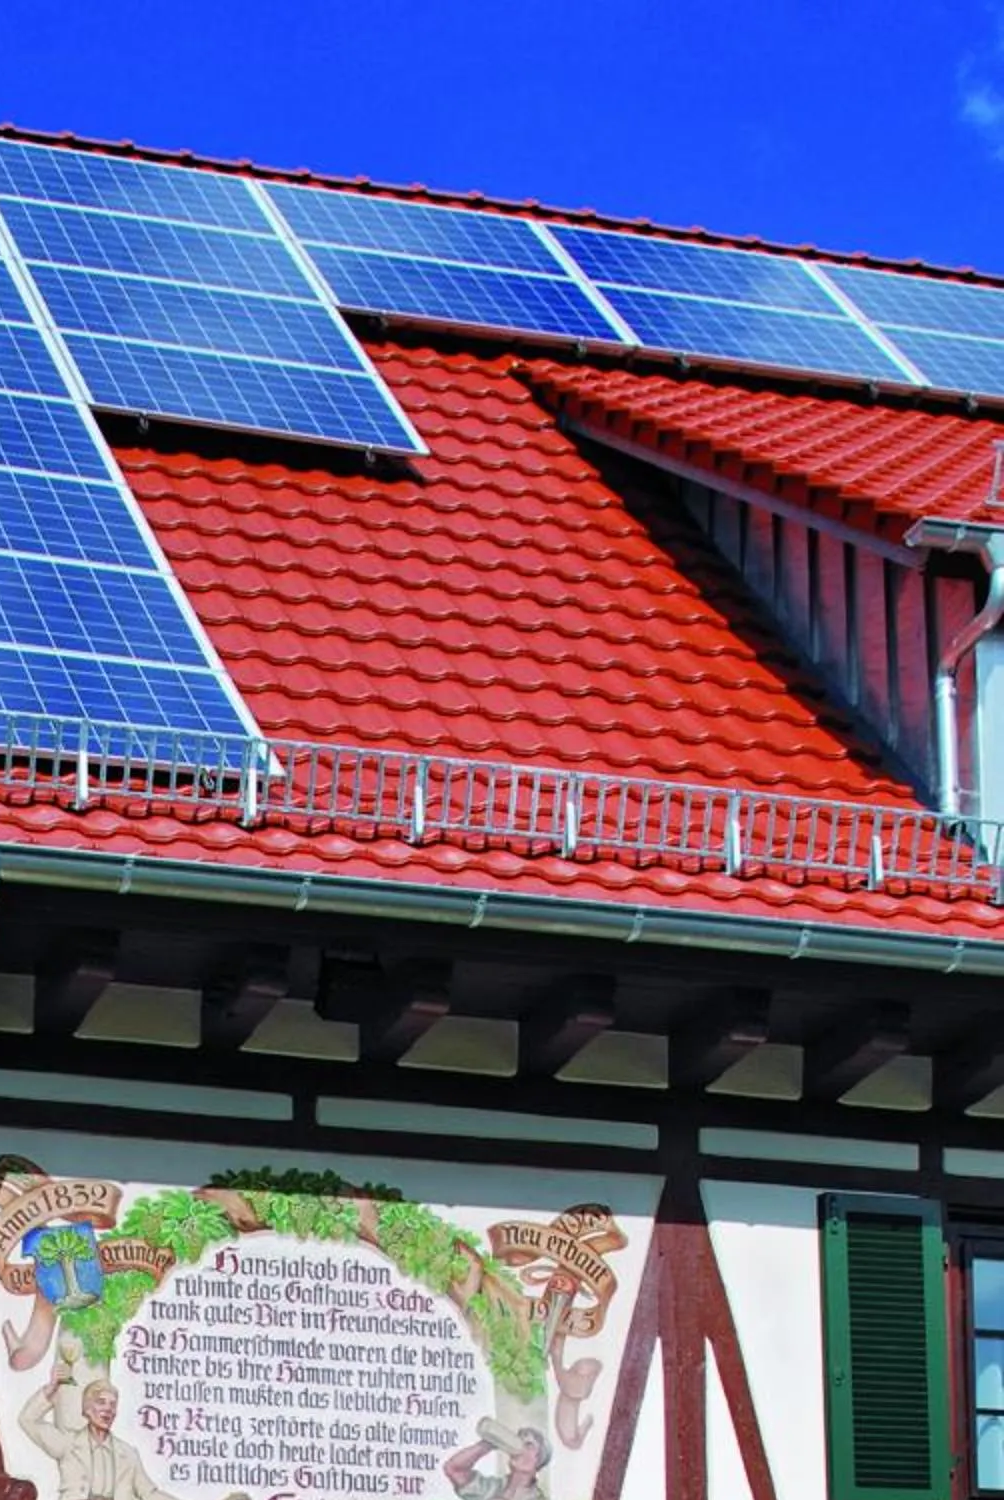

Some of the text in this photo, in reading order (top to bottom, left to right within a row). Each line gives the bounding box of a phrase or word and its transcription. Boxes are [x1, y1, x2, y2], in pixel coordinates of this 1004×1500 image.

[501, 1224, 541, 1246] Neu
[546, 1235, 608, 1283] erbaut
[246, 1278, 281, 1301] das
[150, 1299, 201, 1322] trank
[203, 1304, 253, 1328] gutes
[254, 1303, 297, 1328] Bier
[299, 1308, 326, 1329] im
[126, 1325, 166, 1349] Die
[327, 1342, 387, 1365] waren
[391, 1344, 418, 1366] die
[123, 1350, 201, 1377] Trinker
[205, 1357, 233, 1379] bis
[236, 1358, 273, 1383] ihre
[357, 1366, 416, 1390] ruhten
[420, 1370, 455, 1393] und
[297, 1386, 330, 1409] das
[332, 1389, 403, 1416] liebliche
[137, 1404, 181, 1429] Der
[184, 1408, 243, 1437] Krieg
[328, 1418, 362, 1442] das
[364, 1419, 396, 1443] alte
[234, 1437, 274, 1461] doch
[278, 1440, 326, 1464] heute
[329, 1442, 374, 1467] ladet
[376, 1446, 402, 1468] ein
[168, 1461, 191, 1482] es
[391, 1474, 426, 1496] zur
